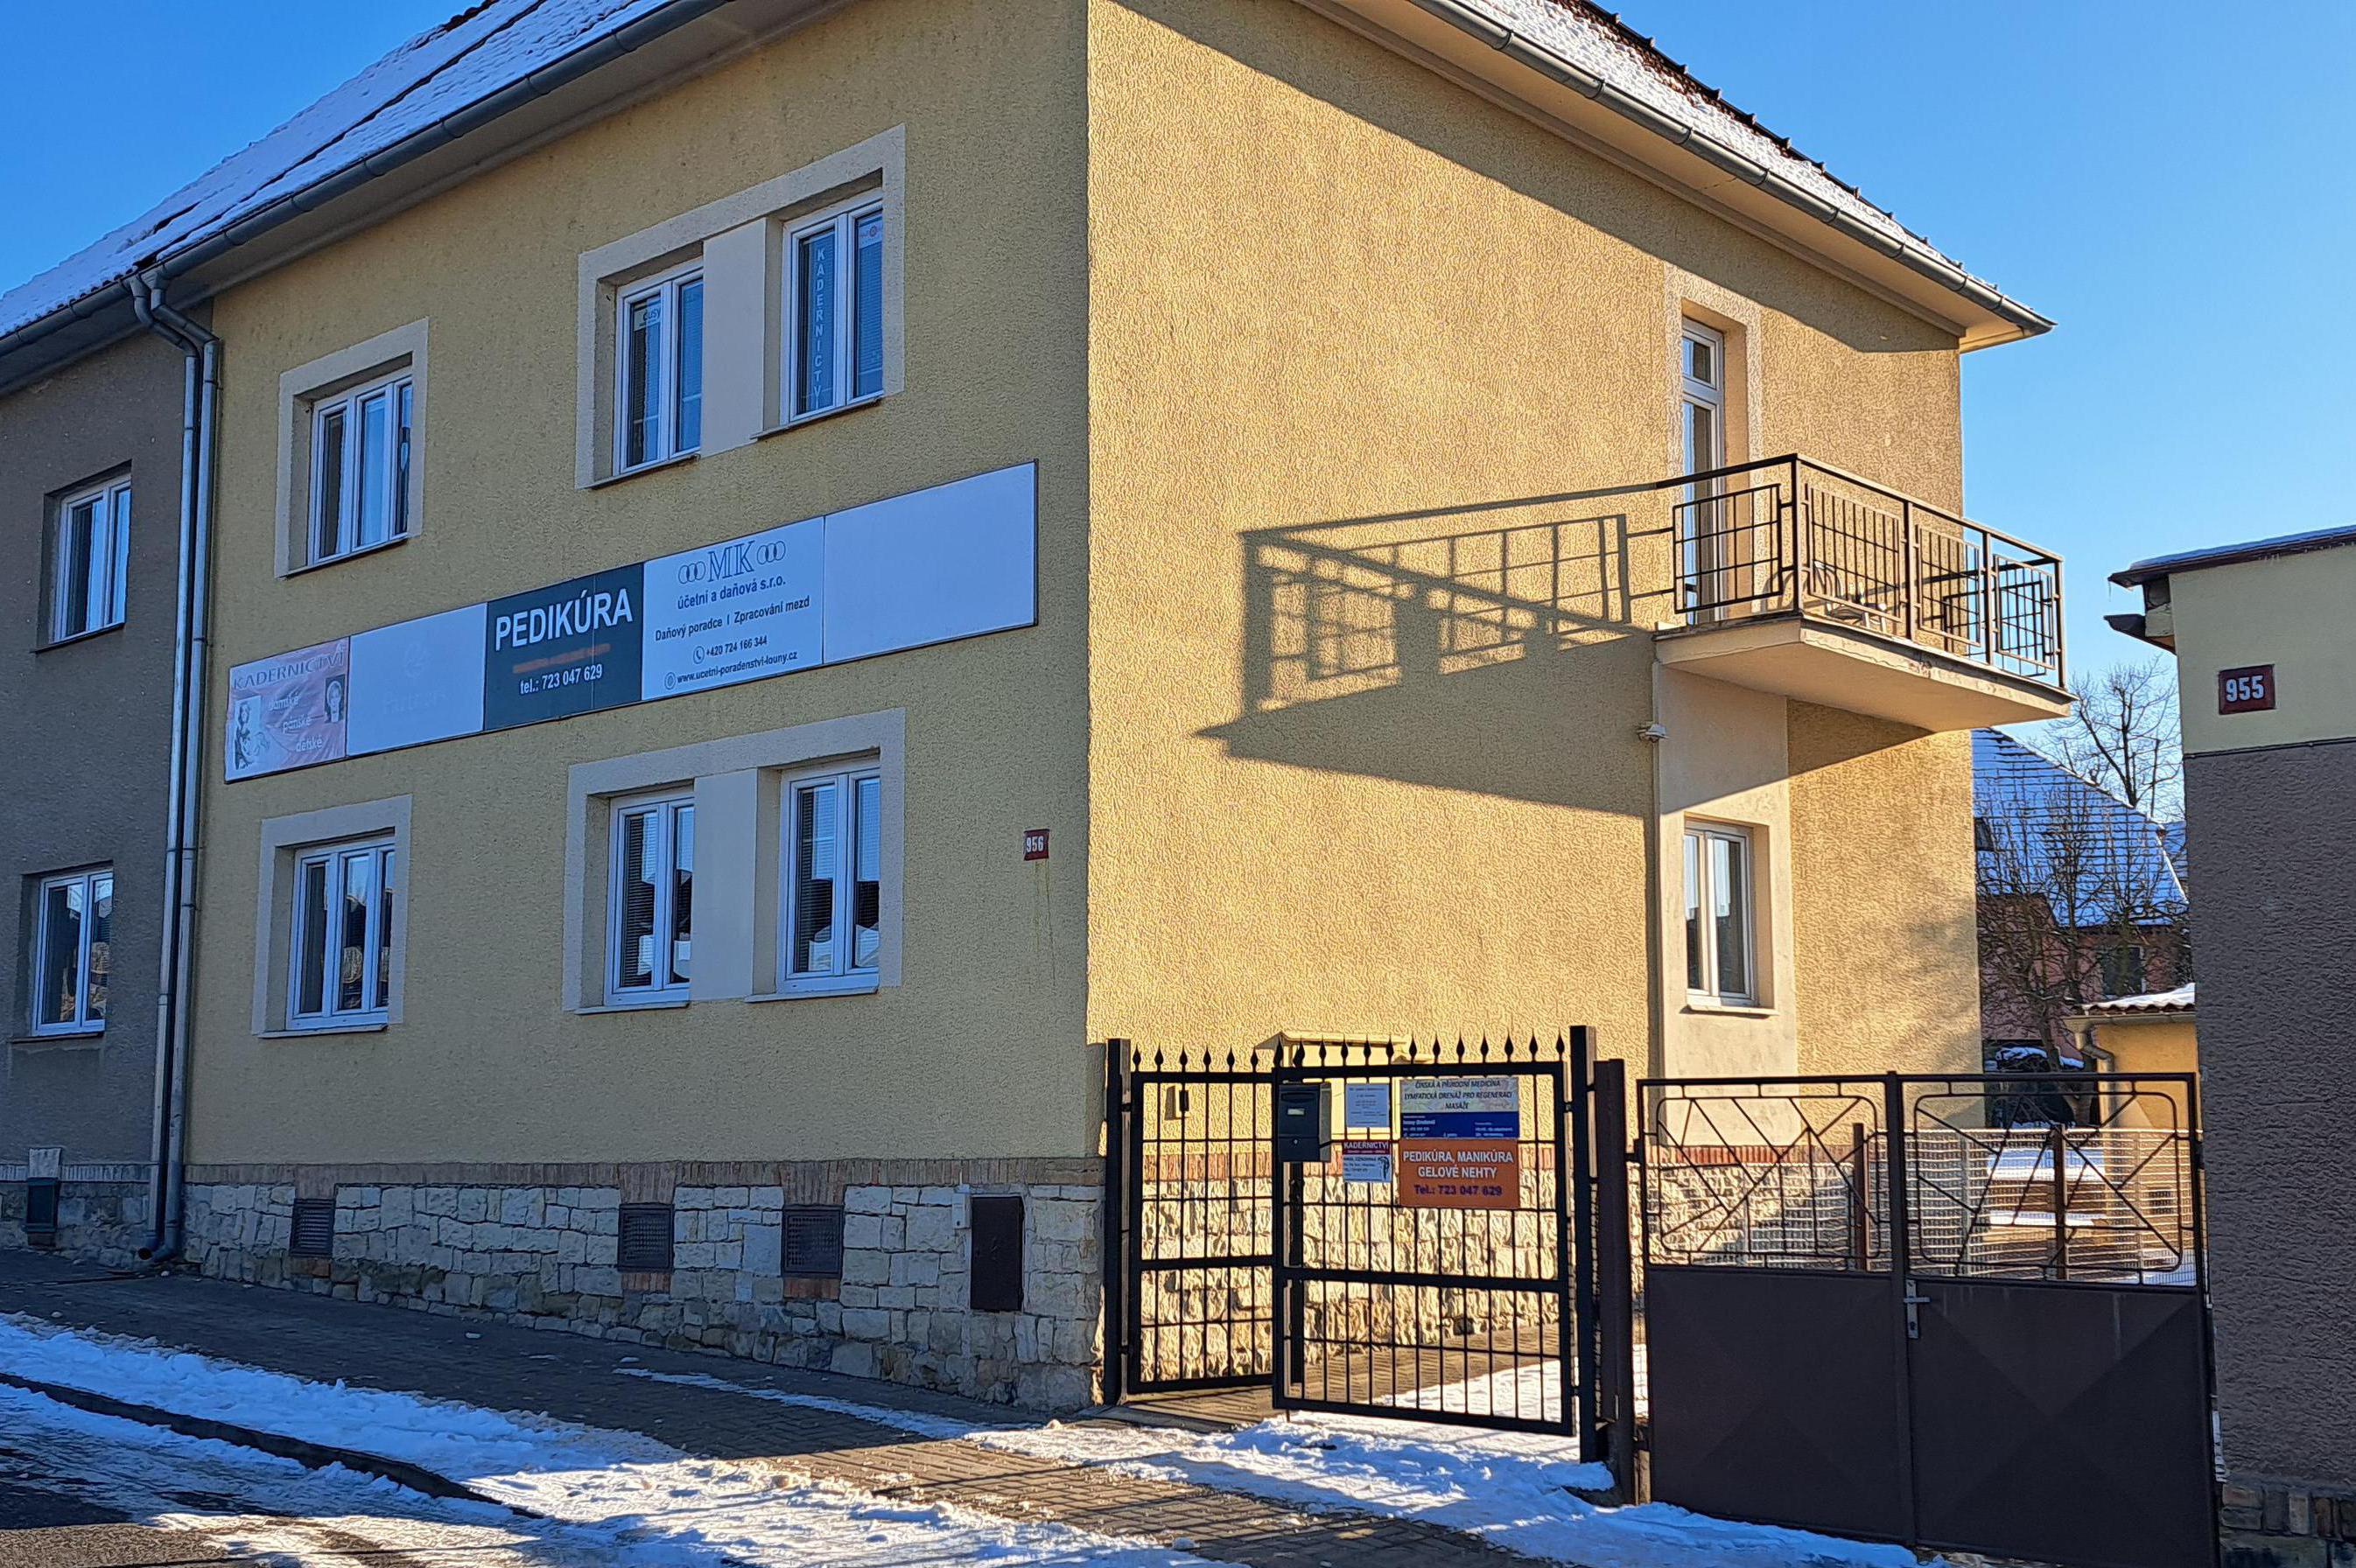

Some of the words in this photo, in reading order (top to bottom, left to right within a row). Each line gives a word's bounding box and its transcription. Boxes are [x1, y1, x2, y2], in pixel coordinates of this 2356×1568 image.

[711, 592, 717, 602] a
[719, 578, 757, 599] daňová
[760, 575, 786, 590] s.r.o.
[495, 588, 633, 652] PEDIKÚRA
[656, 624, 686, 641] Daňový
[689, 618, 723, 637] poradce
[734, 600, 783, 625] Zpracování
[785, 595, 810, 612] mezd
[706, 646, 723, 657] +420
[725, 641, 738, 654] 724
[754, 635, 768, 648] 344
[520, 679, 539, 695] tel.:
[542, 672, 560, 690] 723
[563, 668, 582, 685] 047
[584, 663, 603, 681] 629
[2226, 675, 2264, 702] 955
[1026, 836, 1044, 852] 956
[1403, 1149, 1455, 1163] PEDIKÚRA,
[1457, 1149, 1514, 1163] MANIKÚRA
[1418, 1165, 1459, 1178] GELOVÉ
[1461, 1167, 1497, 1179] NEHTY
[1438, 1185, 1456, 1195] 723
